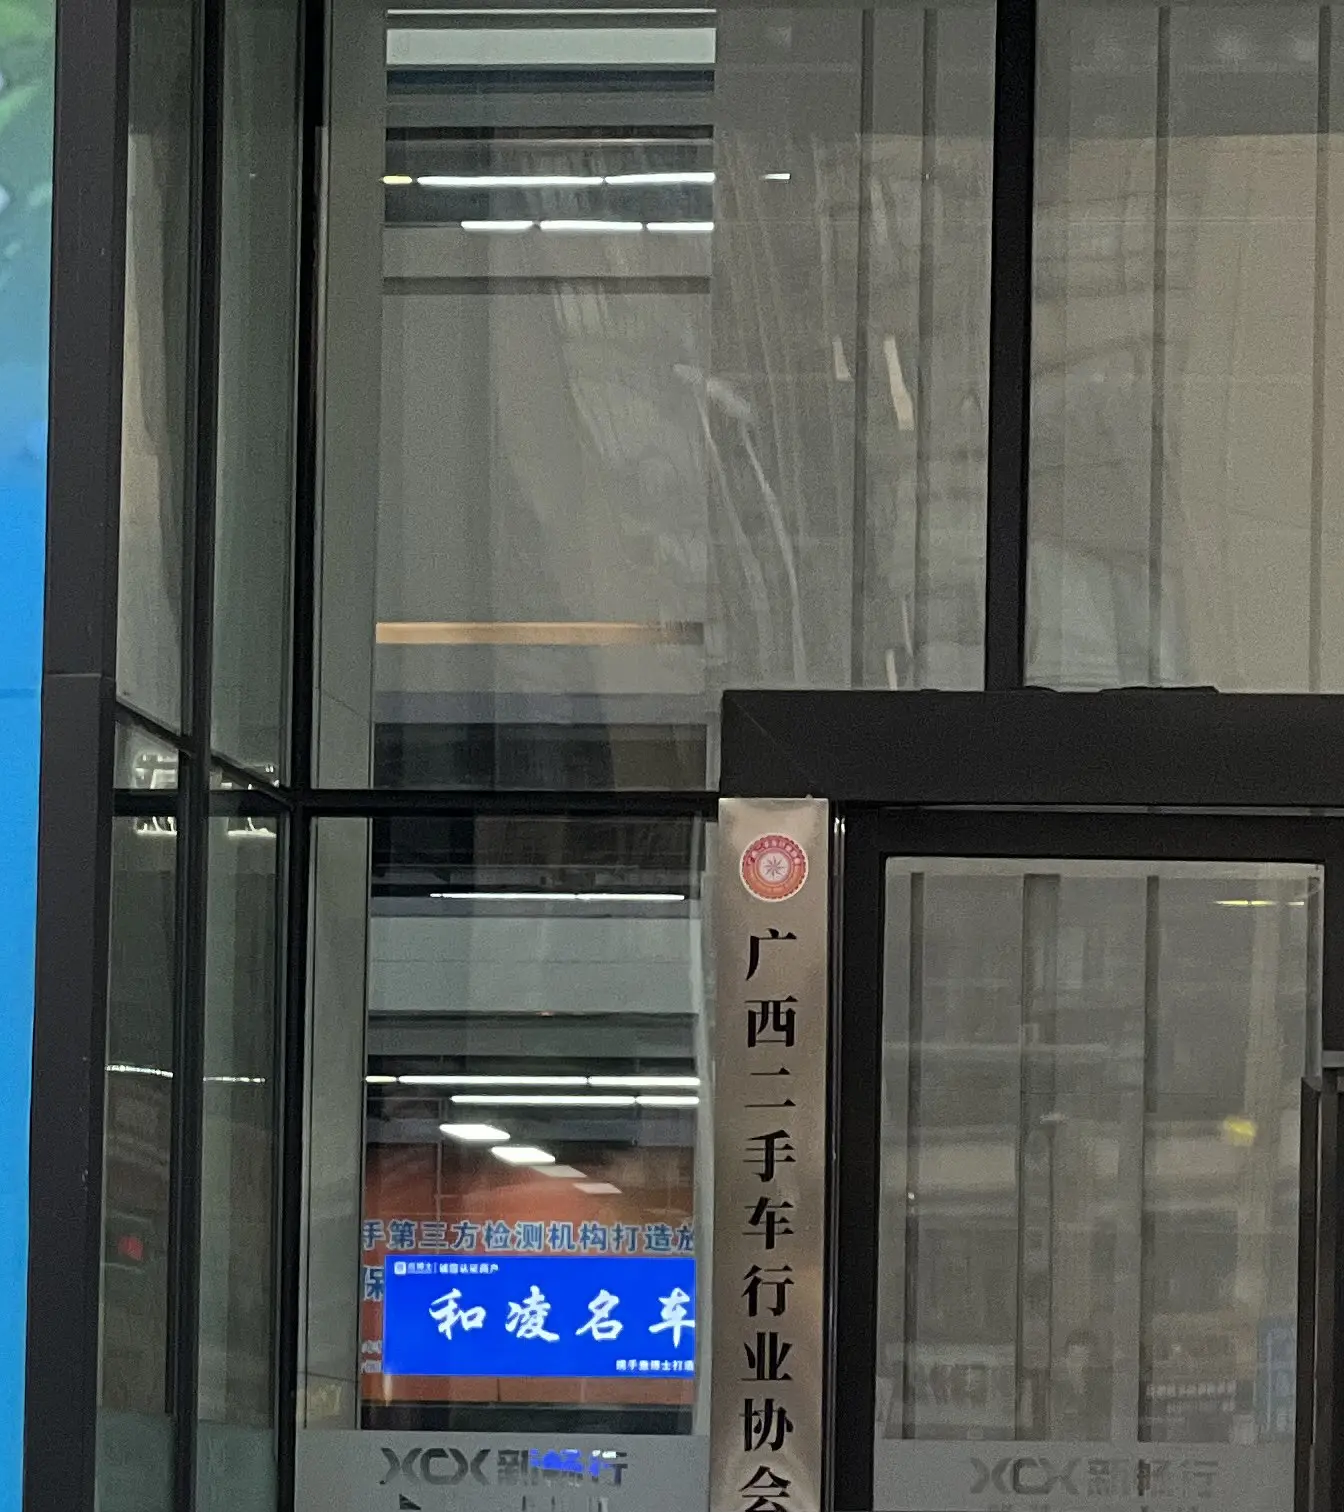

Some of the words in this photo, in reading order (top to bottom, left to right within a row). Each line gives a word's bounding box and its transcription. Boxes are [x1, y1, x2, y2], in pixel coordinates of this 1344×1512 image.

[741, 927, 797, 1512] 广西二手车行业协会
